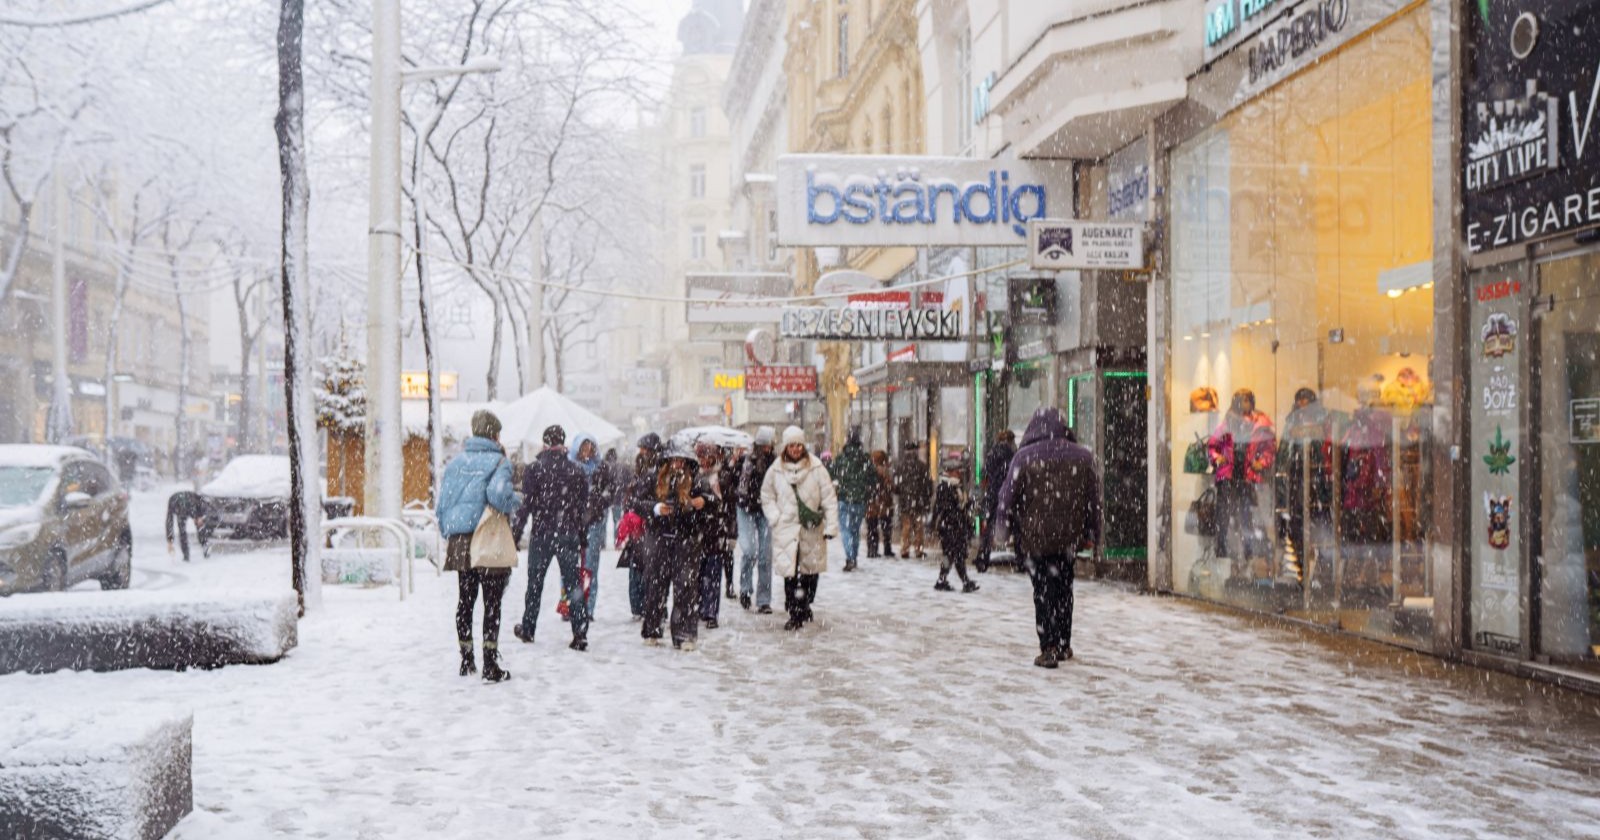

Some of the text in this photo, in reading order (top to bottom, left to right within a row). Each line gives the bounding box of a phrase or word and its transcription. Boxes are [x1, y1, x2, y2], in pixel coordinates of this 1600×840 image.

[1248, 0, 1348, 84] IMPERIO
[1466, 155, 1500, 190] CITY
[806, 166, 1046, 237] bständig
[1467, 187, 1600, 252] E-ZIGARE
[1081, 227, 1134, 239] AUGENARZT
[1483, 383, 1516, 410] BOYZ
